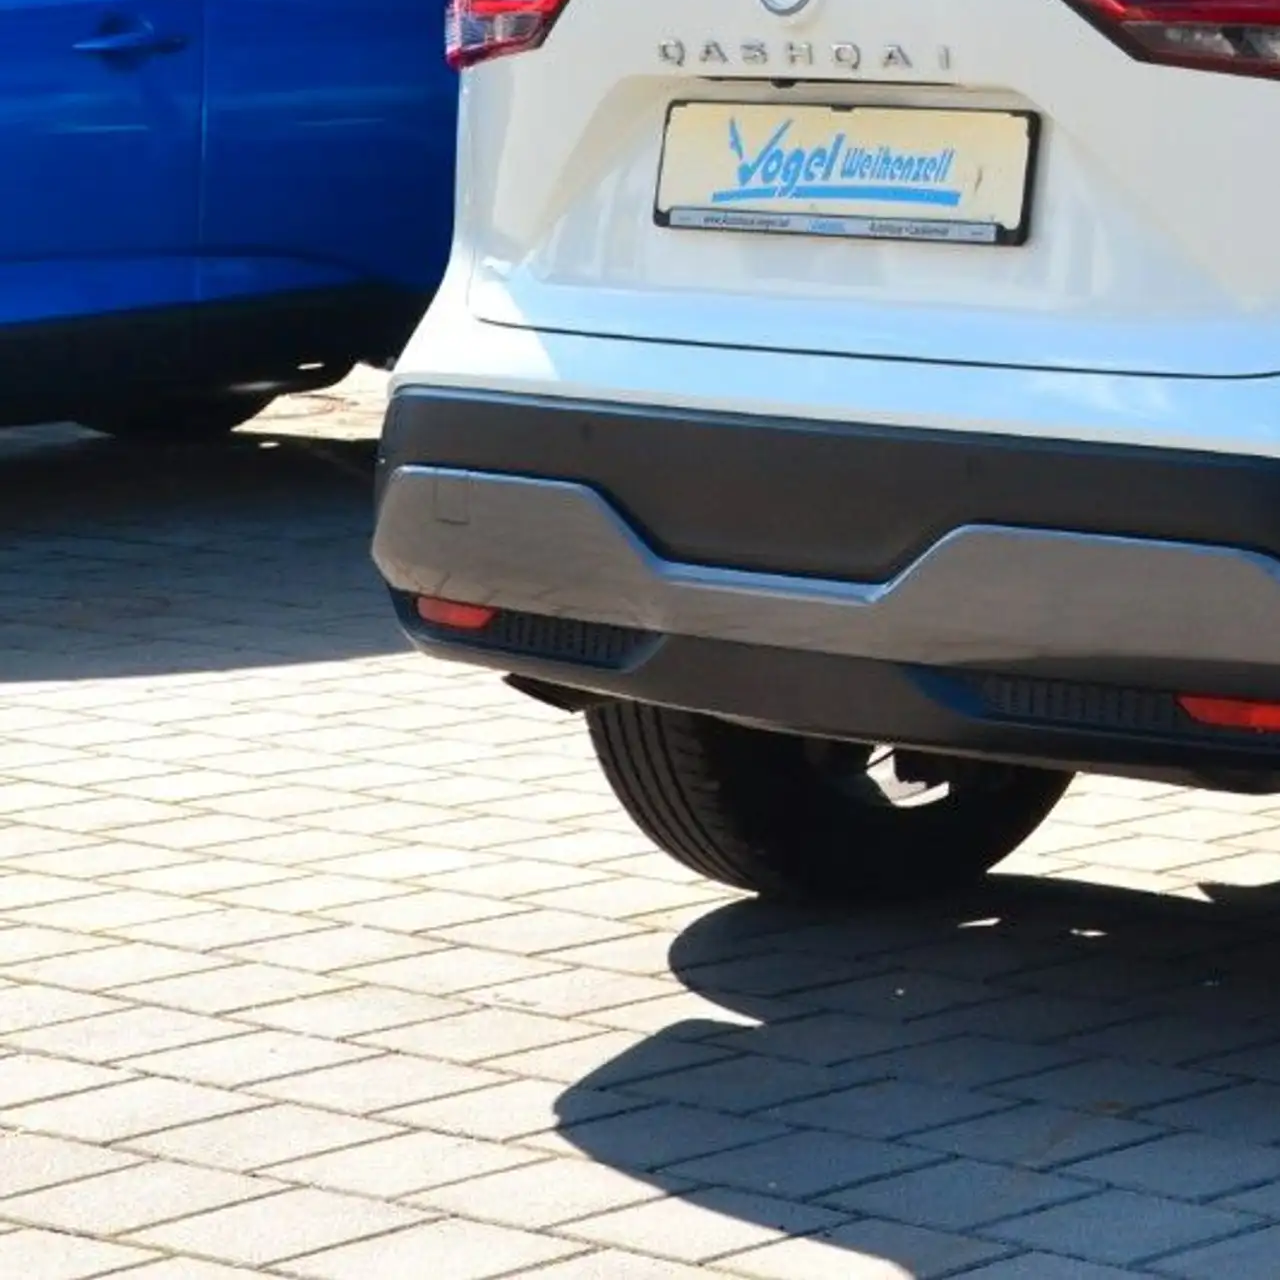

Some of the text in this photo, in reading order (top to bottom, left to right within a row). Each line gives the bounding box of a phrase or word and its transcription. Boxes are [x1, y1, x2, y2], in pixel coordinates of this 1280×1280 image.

[658, 37, 951, 71] QASHQAI
[729, 117, 956, 199] Vogel Weihenzell
